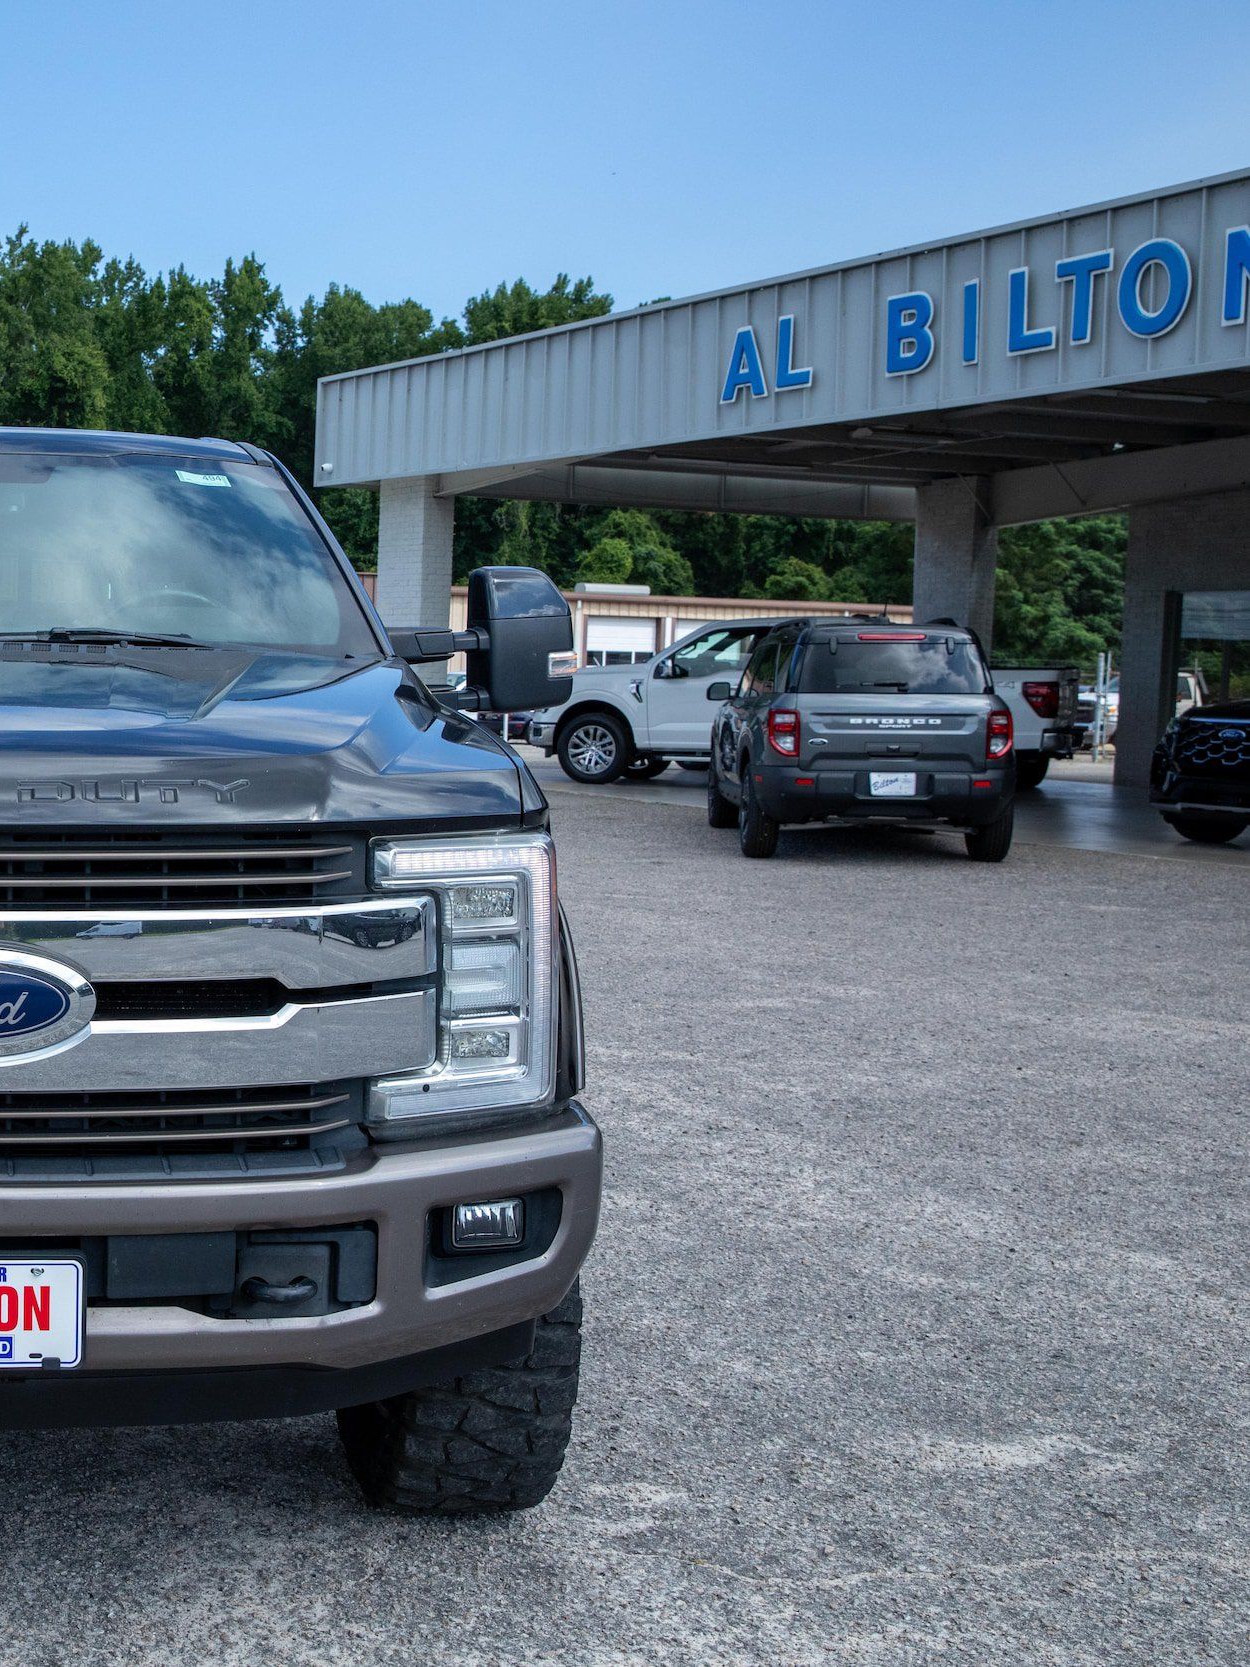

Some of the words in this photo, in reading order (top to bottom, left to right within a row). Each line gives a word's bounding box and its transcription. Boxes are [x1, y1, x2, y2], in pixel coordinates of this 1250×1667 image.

[720, 314, 813, 405] AL
[16, 778, 251, 804] DUTY
[871, 777, 899, 791] Bilton
